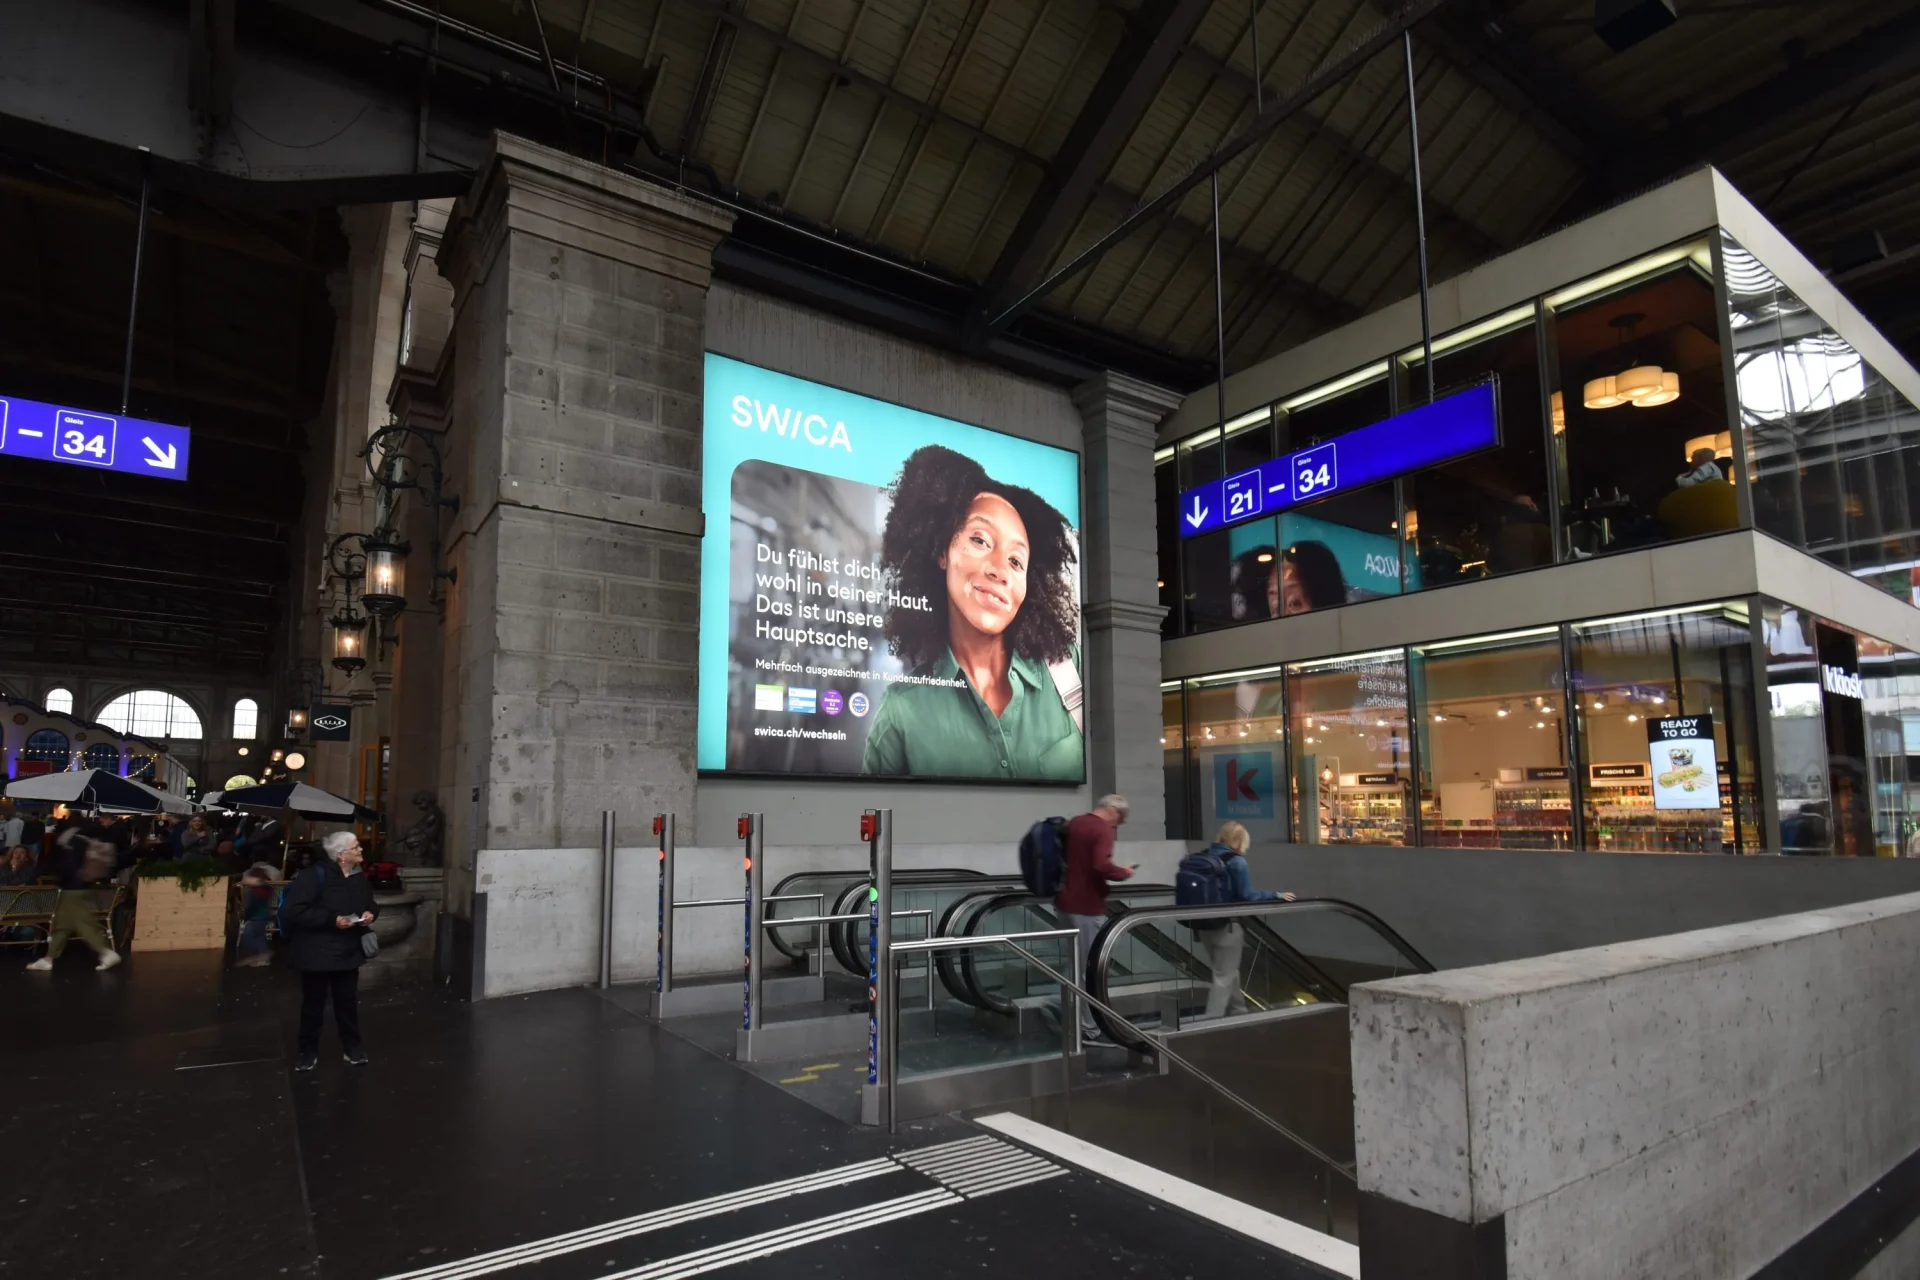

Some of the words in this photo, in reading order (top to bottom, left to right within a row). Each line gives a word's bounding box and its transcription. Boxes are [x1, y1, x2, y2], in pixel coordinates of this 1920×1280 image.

[64, 417, 84, 426] Gleis
[731, 395, 853, 453] SWICA
[62, 430, 106, 458] 34
[1297, 457, 1312, 466] Gleis
[1227, 482, 1240, 490] Gleis
[1230, 489, 1253, 516] 21
[1299, 464, 1330, 493] 34
[757, 543, 782, 565] Du
[787, 549, 839, 575] fühlst
[844, 559, 881, 581] dich
[756, 573, 801, 593] wohl
[806, 576, 822, 596] in
[827, 580, 884, 605] deiner
[888, 589, 933, 612] Haut.
[756, 594, 793, 617] Das
[798, 600, 820, 620] ist
[825, 608, 884, 628] unsere
[755, 619, 873, 651] Hauptsache.
[755, 658, 803, 673] Mehrfach
[805, 665, 870, 680] ausgezeichnet
[872, 670, 880, 680] in
[882, 671, 968, 689] Kundenzufriedenheit.
[754, 726, 847, 741] swica.ch/wechseln
[1660, 719, 1698, 729] READY
[1662, 729, 1678, 738] TO
[1680, 728, 1698, 737] GO
[1226, 759, 1261, 801] k
